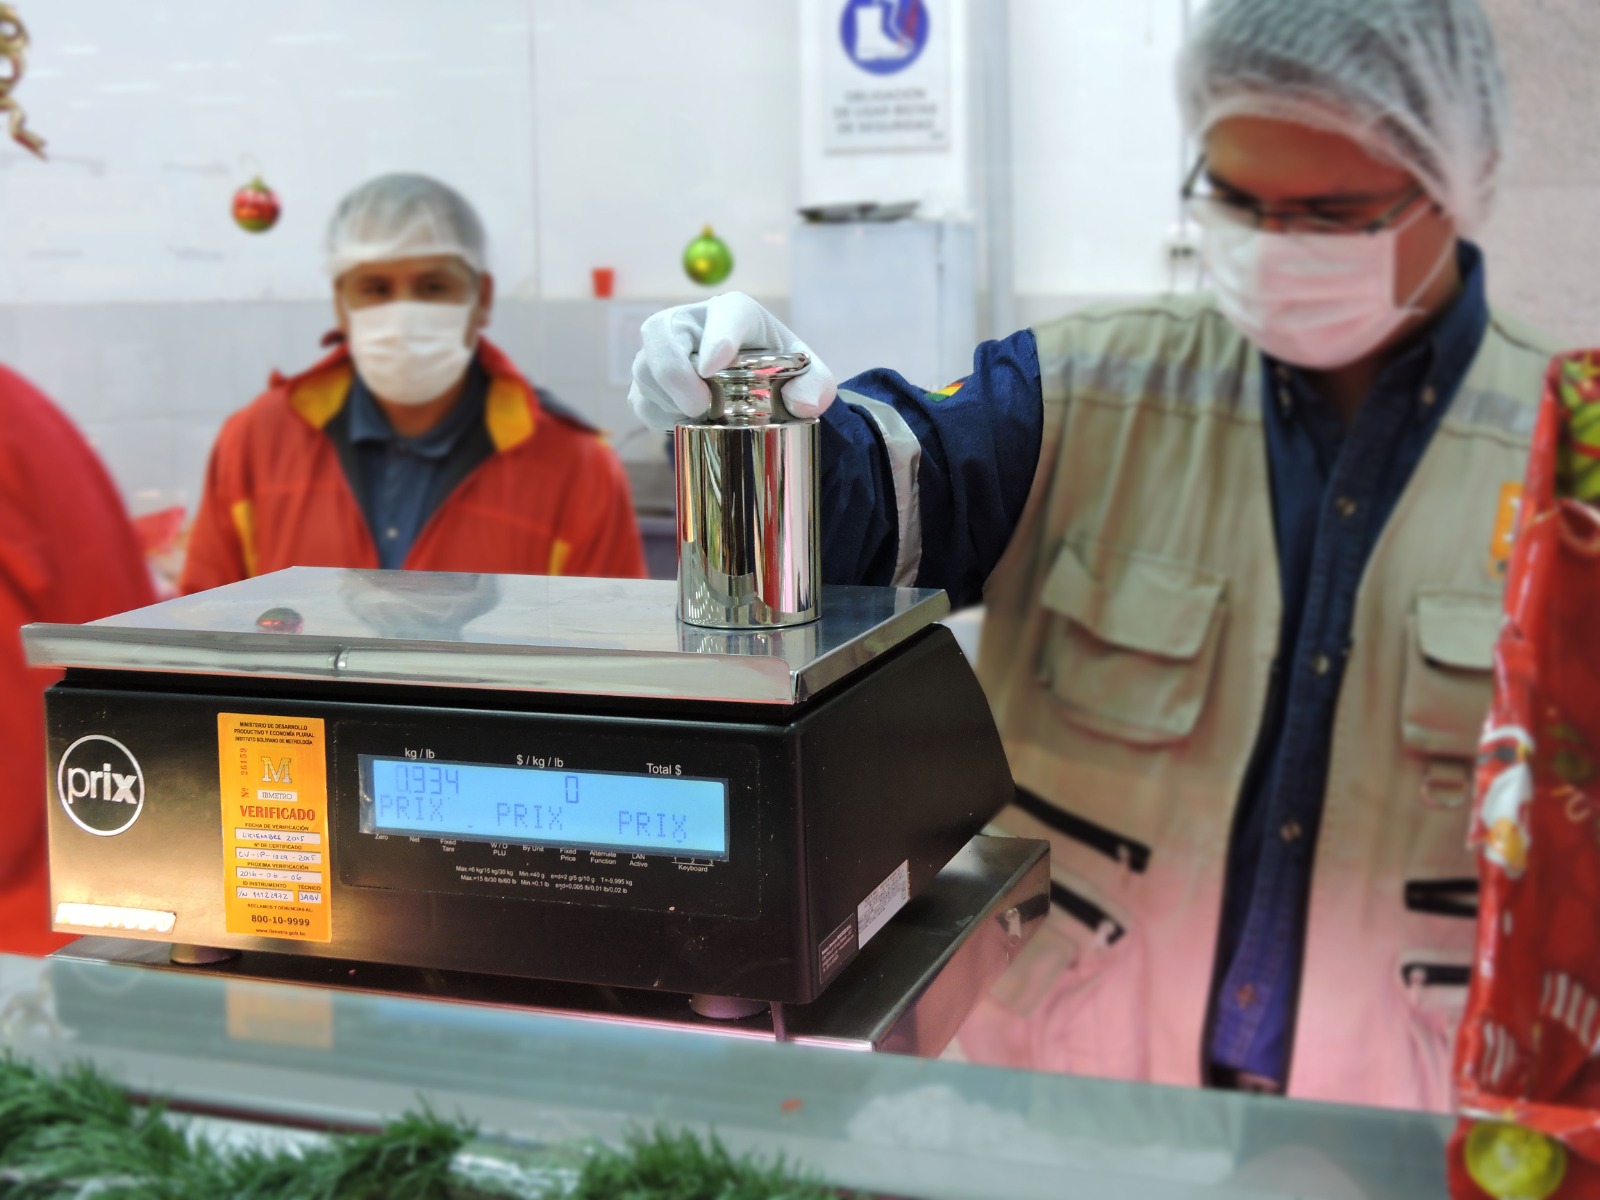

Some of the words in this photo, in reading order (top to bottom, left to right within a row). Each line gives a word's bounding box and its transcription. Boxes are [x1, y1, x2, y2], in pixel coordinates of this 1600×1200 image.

[405, 748, 417, 760] kg
[420, 749, 423, 758] /
[426, 749, 435, 759] lb
[240, 748, 248, 775] 26159
[516, 755, 523, 766] $
[526, 756, 530, 766] /
[532, 757, 544, 768] kg
[548, 757, 551, 767] /
[554, 758, 563, 767] lb
[261, 756, 292, 784] M
[646, 763, 672, 774] Total
[675, 764, 682, 776] $
[68, 763, 137, 804] prix
[240, 805, 315, 820] VERIFICADO
[380, 794, 443, 822] PRIX
[496, 802, 562, 830] PRIX
[619, 811, 687, 839] PRIX
[440, 838, 456, 846] Fixed
[590, 850, 616, 858] Alternate
[272, 862, 309, 870] VERIFICACIÓN
[590, 857, 616, 865] Function
[630, 860, 648, 868] Active
[251, 915, 310, 926] 800-10-9999
